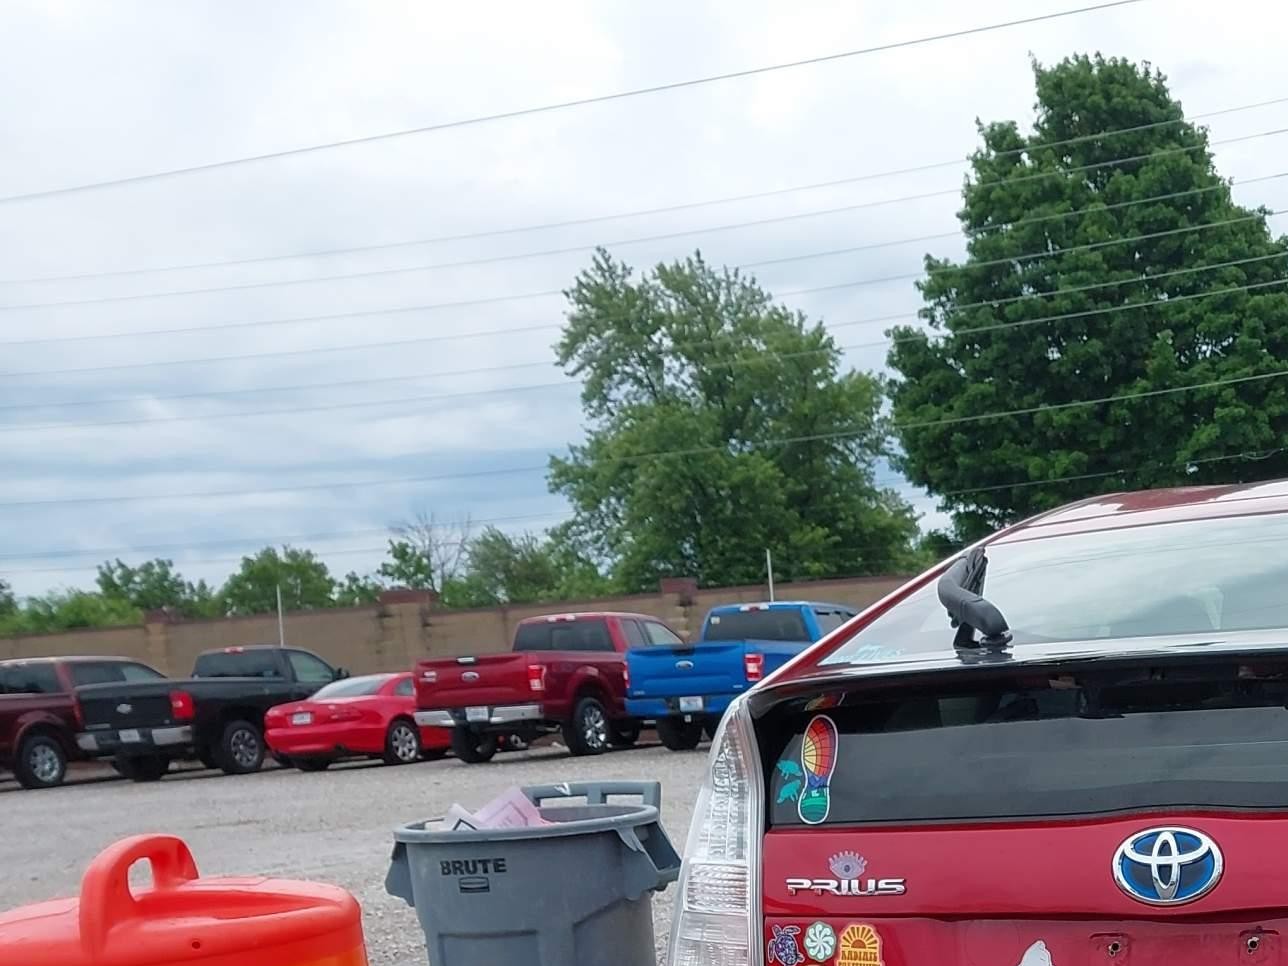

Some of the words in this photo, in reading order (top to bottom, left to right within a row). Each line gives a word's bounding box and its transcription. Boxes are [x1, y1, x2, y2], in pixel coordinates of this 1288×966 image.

[440, 858, 507, 875] BRUTE
[786, 878, 905, 896] PRIUS
[841, 950, 878, 962] RADIATE
